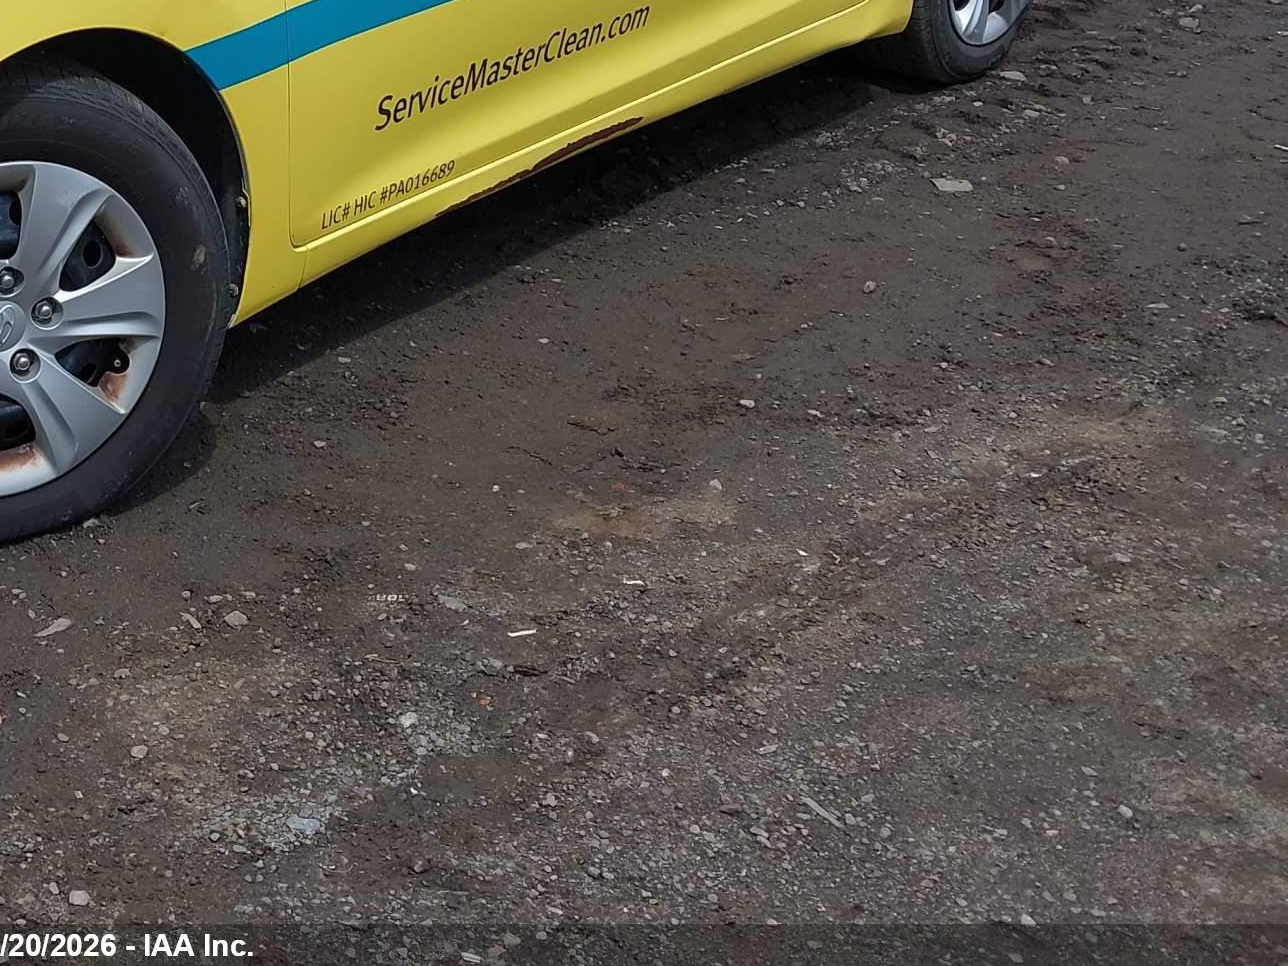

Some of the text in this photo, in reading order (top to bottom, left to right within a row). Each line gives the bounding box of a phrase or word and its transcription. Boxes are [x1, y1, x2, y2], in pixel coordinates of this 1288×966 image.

[374, 4, 651, 131] ServiceMasterClean.com
[321, 159, 456, 230] LIC# HIC #PA016689
